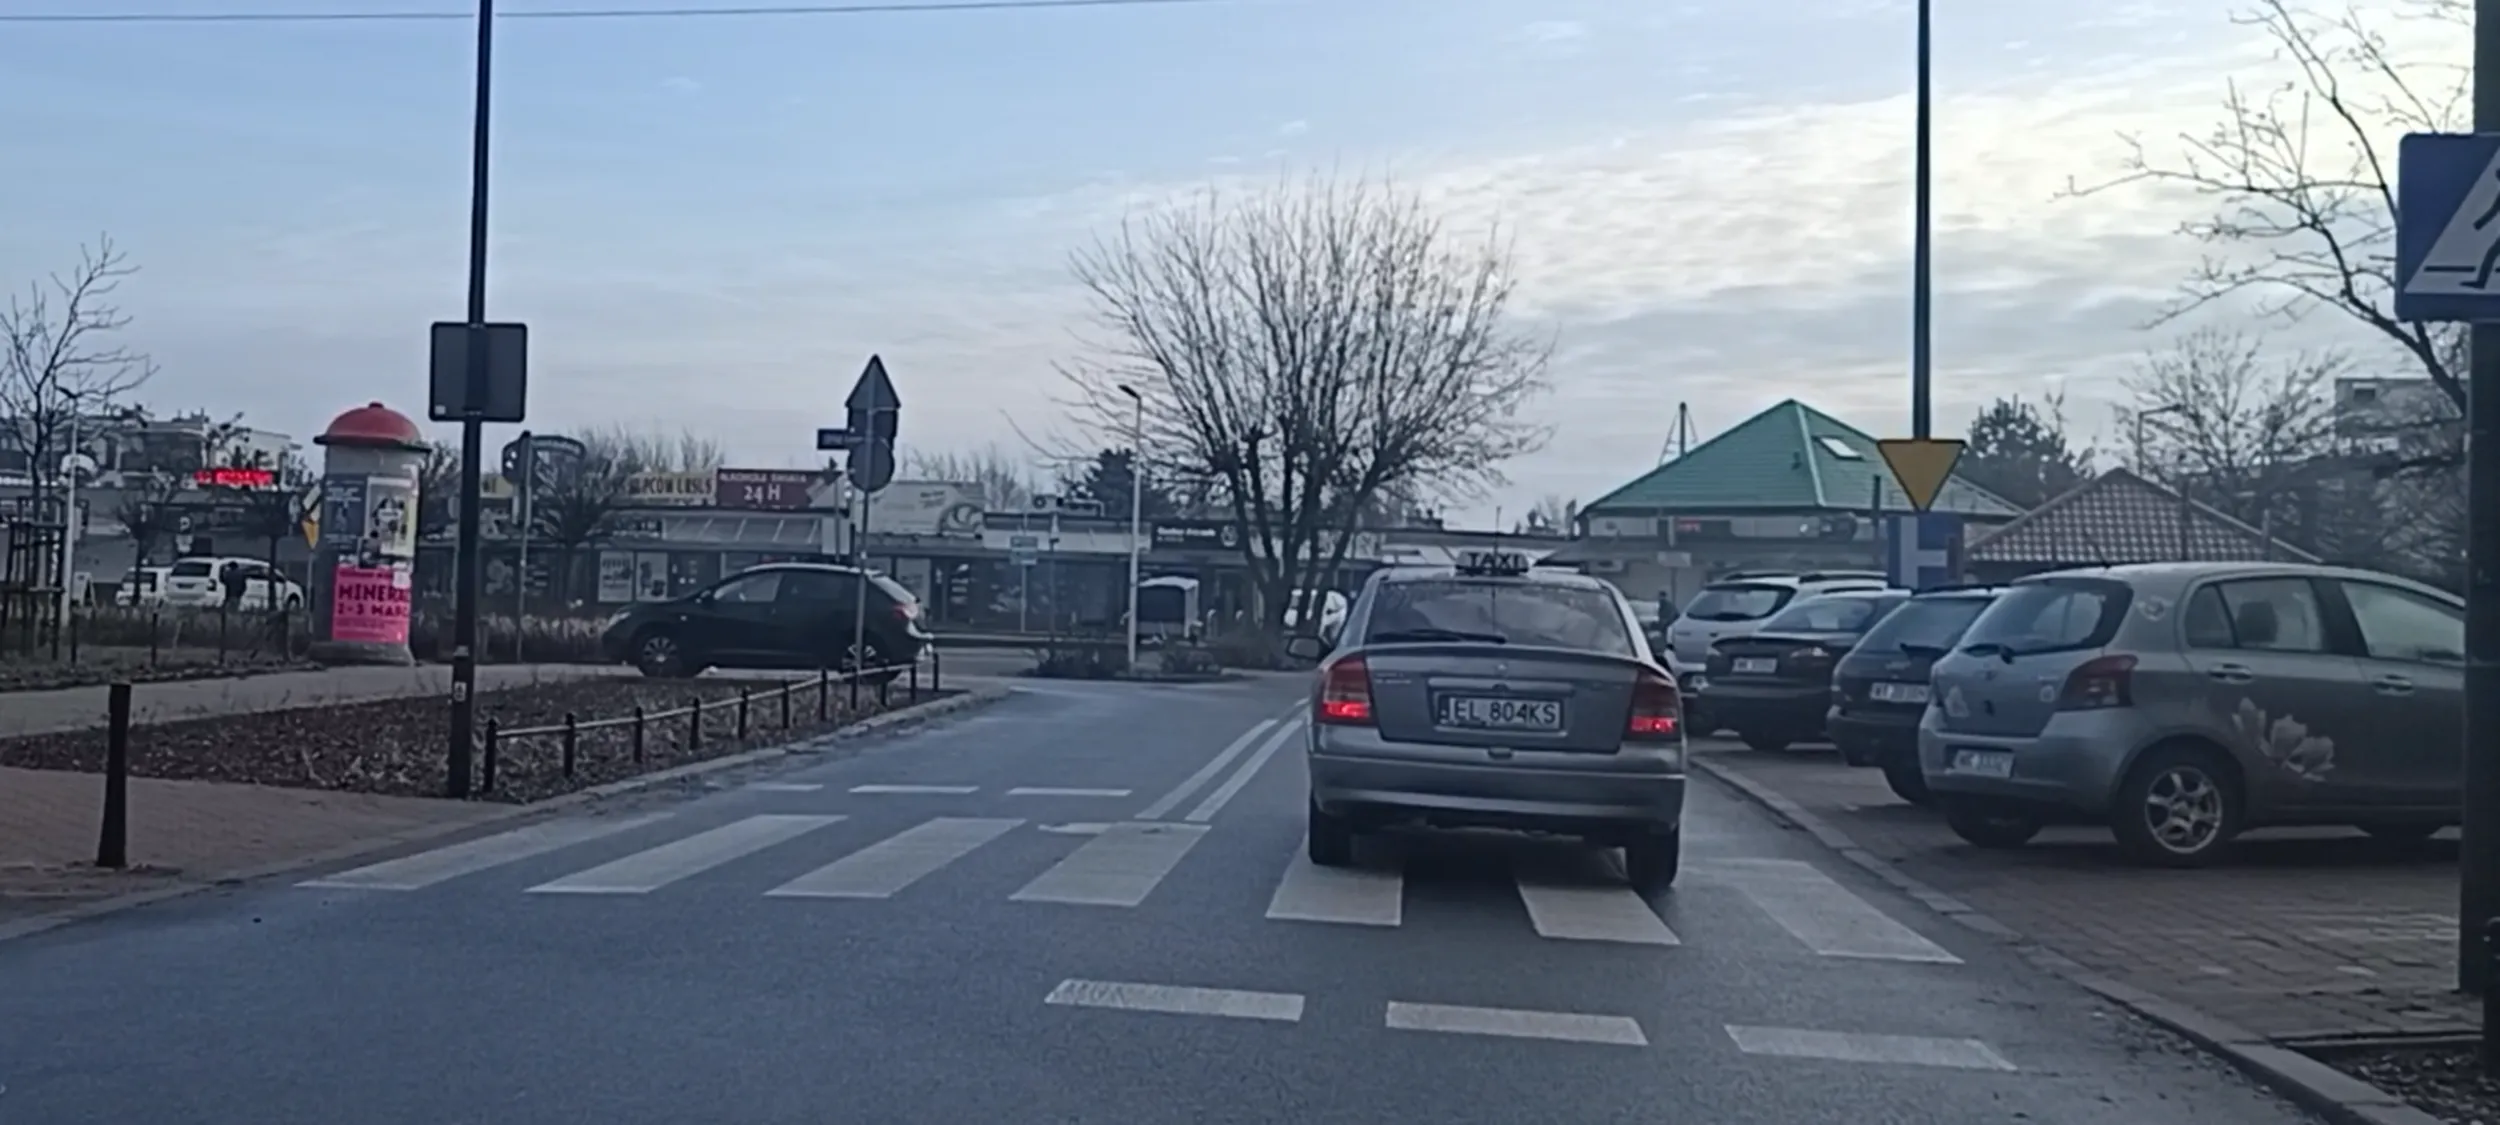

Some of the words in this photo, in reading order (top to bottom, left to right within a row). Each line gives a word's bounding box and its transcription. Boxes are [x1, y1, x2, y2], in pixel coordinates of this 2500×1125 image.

[743, 485, 763, 504] 24
[767, 483, 780, 501] H
[1467, 552, 1520, 569] TAXI
[1454, 699, 1481, 720] EL
[1490, 702, 1557, 724] 804KS
